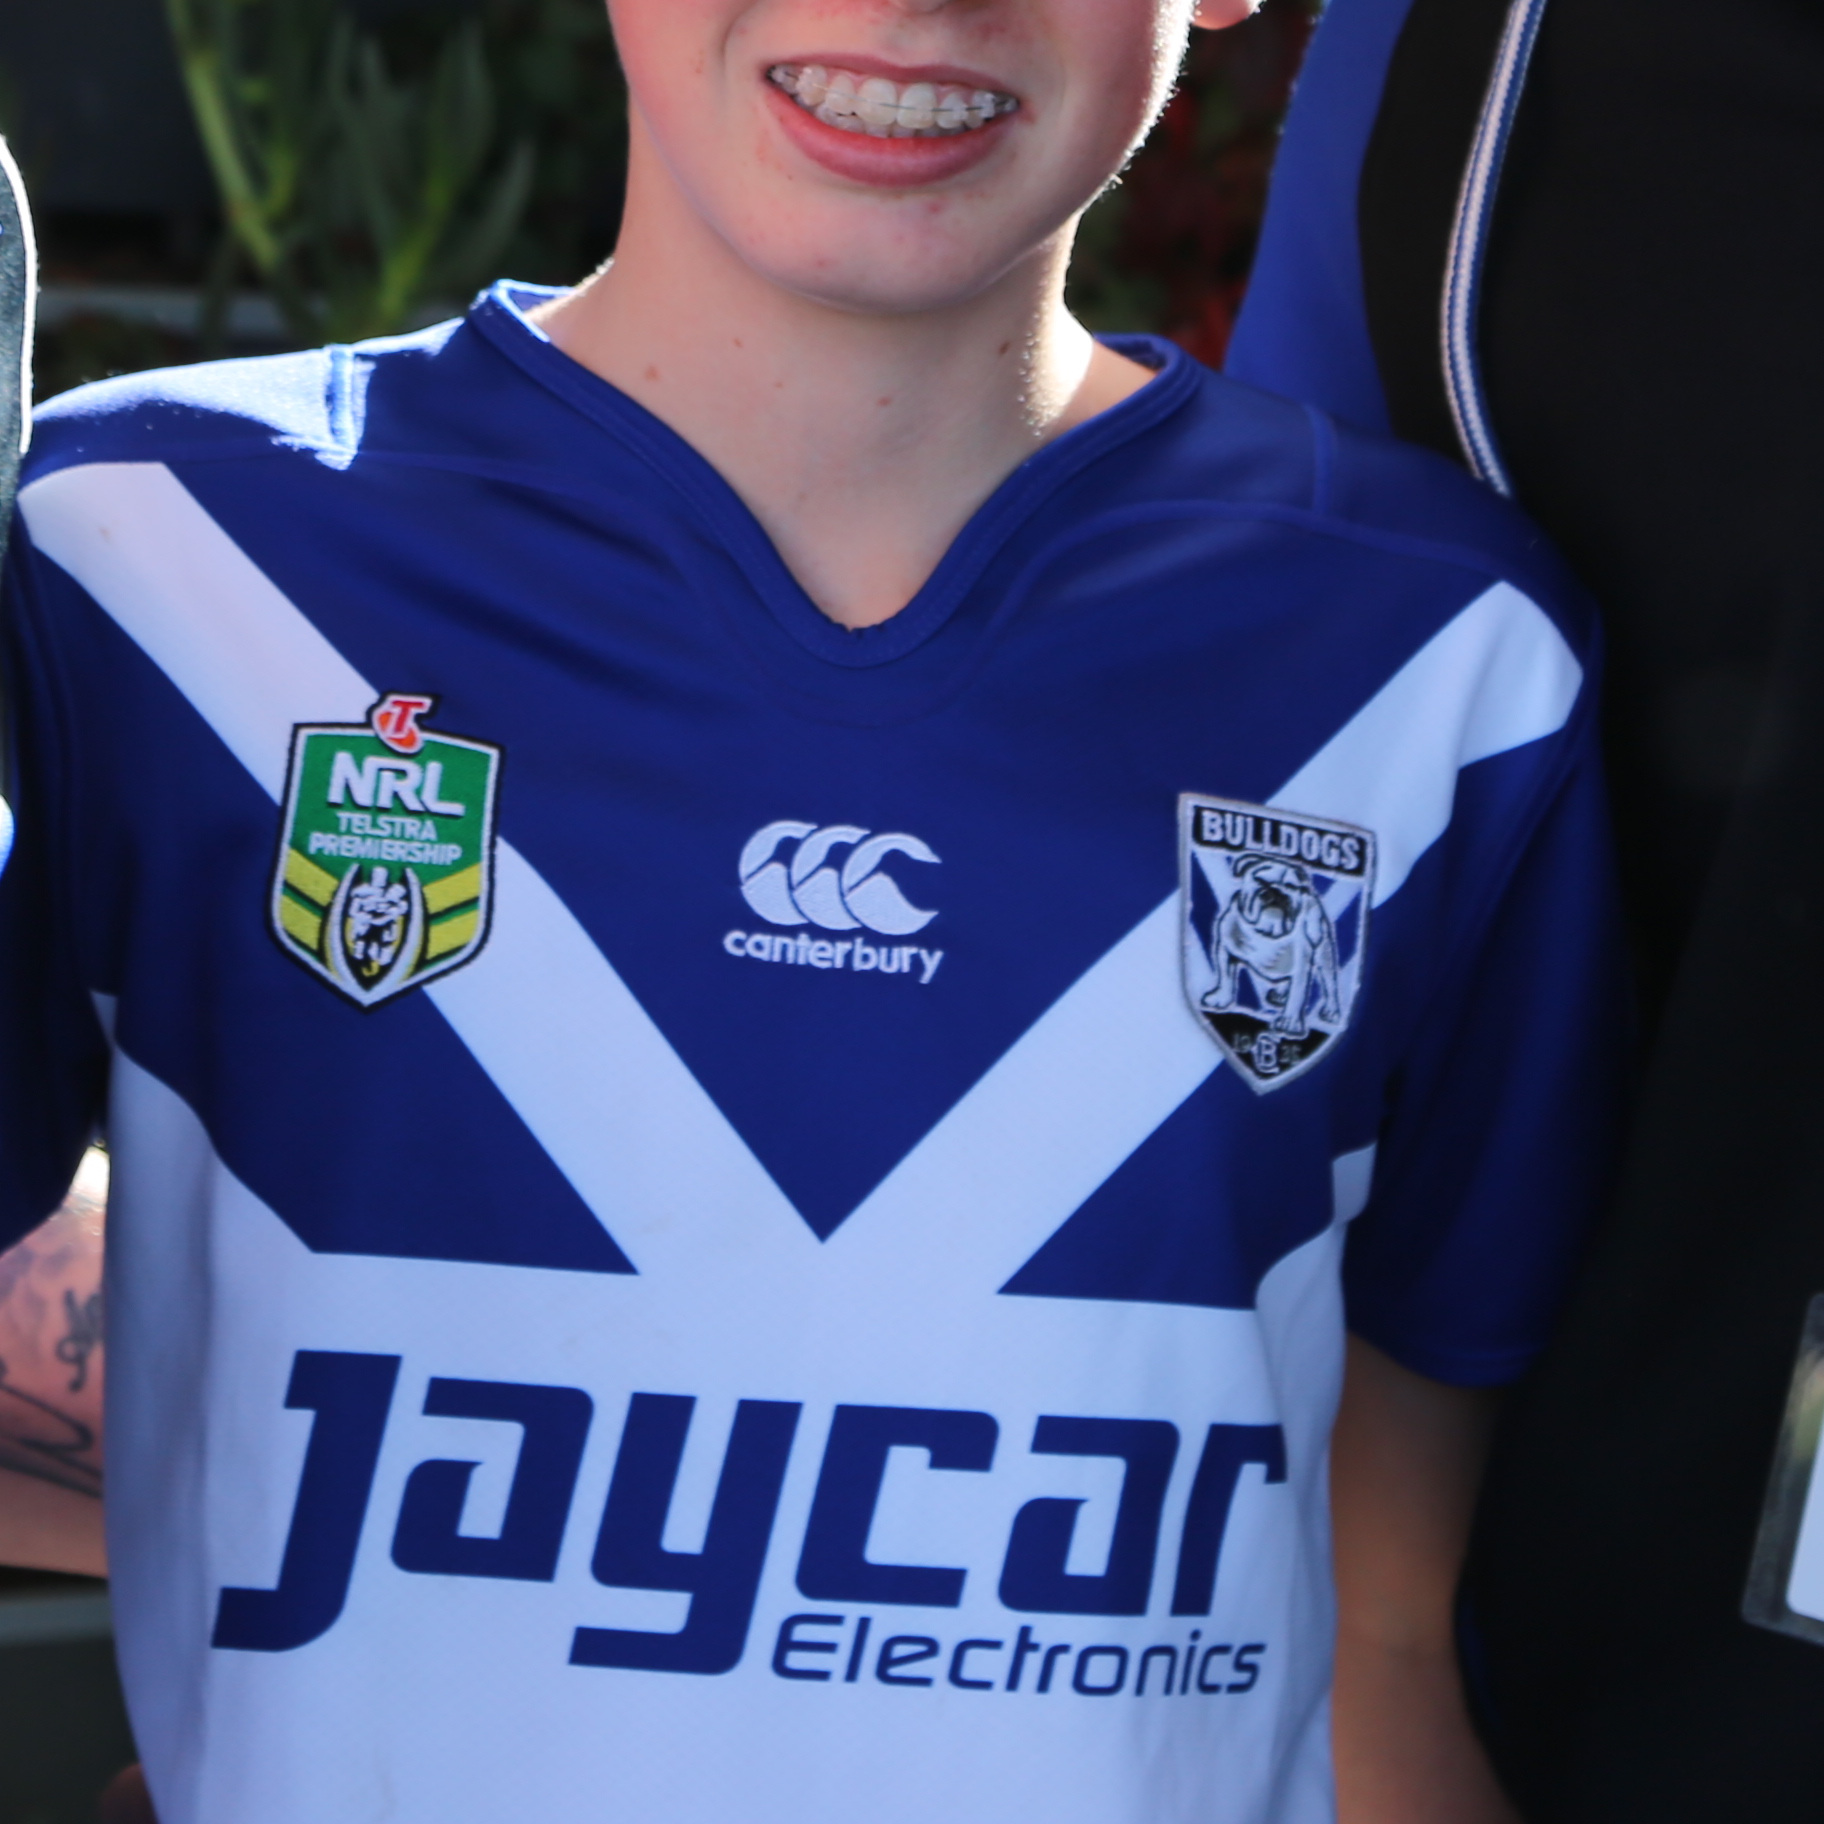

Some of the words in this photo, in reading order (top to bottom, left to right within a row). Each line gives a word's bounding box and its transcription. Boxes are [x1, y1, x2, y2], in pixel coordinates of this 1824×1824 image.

[327, 751, 466, 816] NRL
[308, 831, 463, 866] PREMIERSHIP
[336, 811, 438, 842] TELSTRA
[1201, 808, 1363, 872] BULLDOGS
[722, 928, 943, 984] canterbury
[211, 1348, 1288, 1677] Jaycar
[771, 1613, 1267, 1697] Electronics
